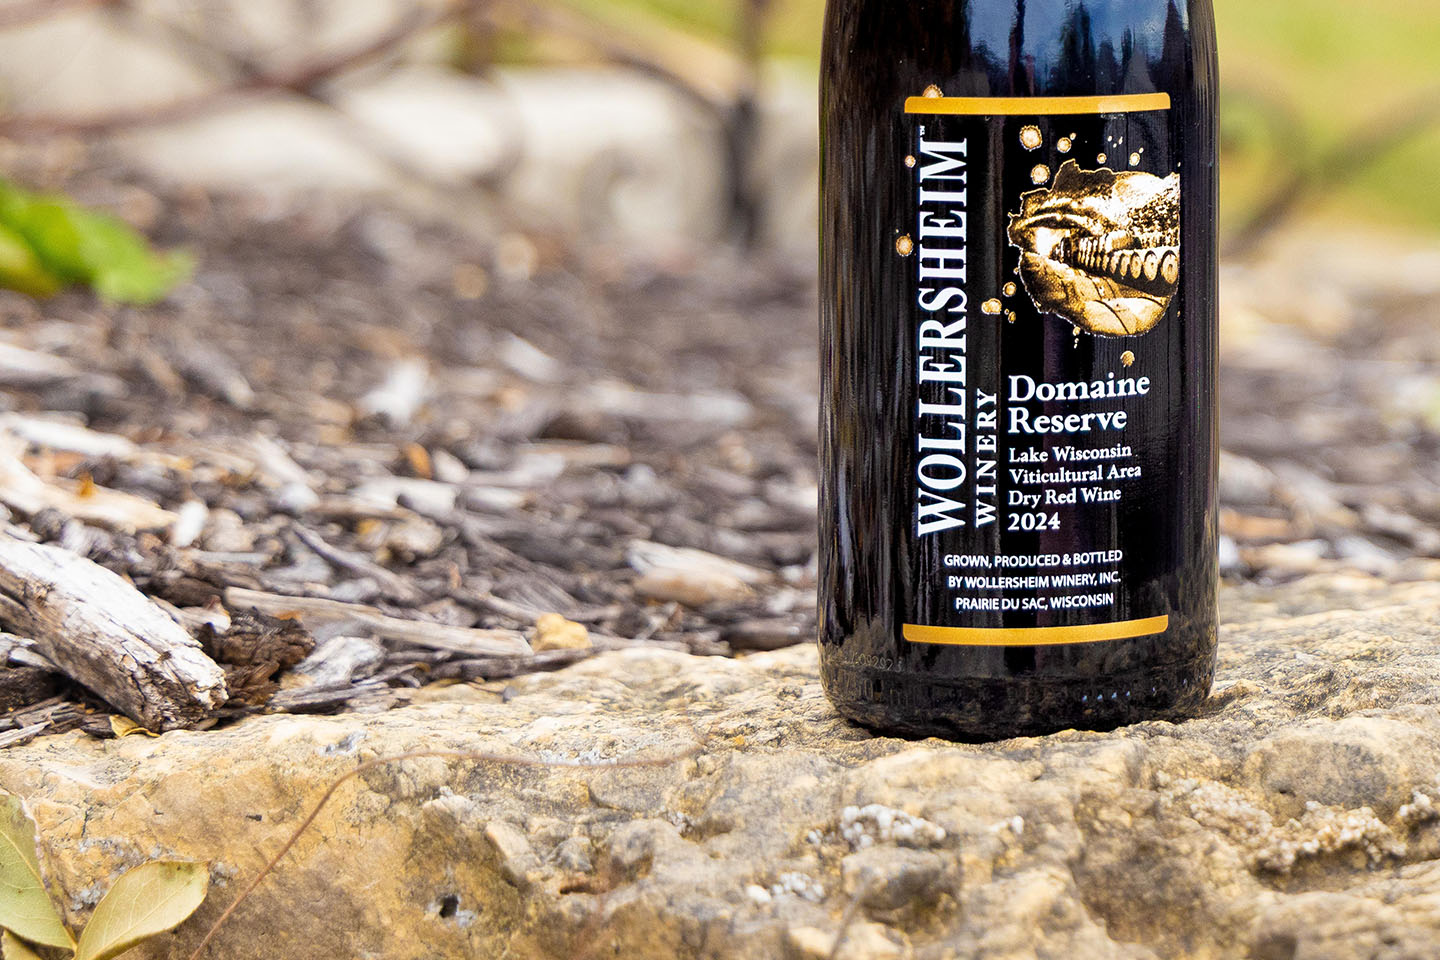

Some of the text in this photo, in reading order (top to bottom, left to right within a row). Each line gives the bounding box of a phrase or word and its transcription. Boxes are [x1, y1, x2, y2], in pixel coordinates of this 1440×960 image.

[918, 138, 968, 538] WOLLERSHEIM
[1008, 372, 1151, 402] Domaine
[1007, 407, 1128, 434] Reserve
[975, 388, 998, 529] WINERY
[1009, 443, 1133, 463] Lake Wisconsin
[1008, 464, 1143, 485] Viticultural Area
[1008, 486, 1123, 509] Dry Red Wine
[1007, 512, 1061, 531] 2024
[944, 549, 1123, 569] GROWN, PRODUCED & BOTTLED
[948, 570, 1122, 590] BY WOLLERSHEIM WINERY, INC.
[955, 592, 1114, 611] PRAIRIE DU SAC, WISCONSIN
